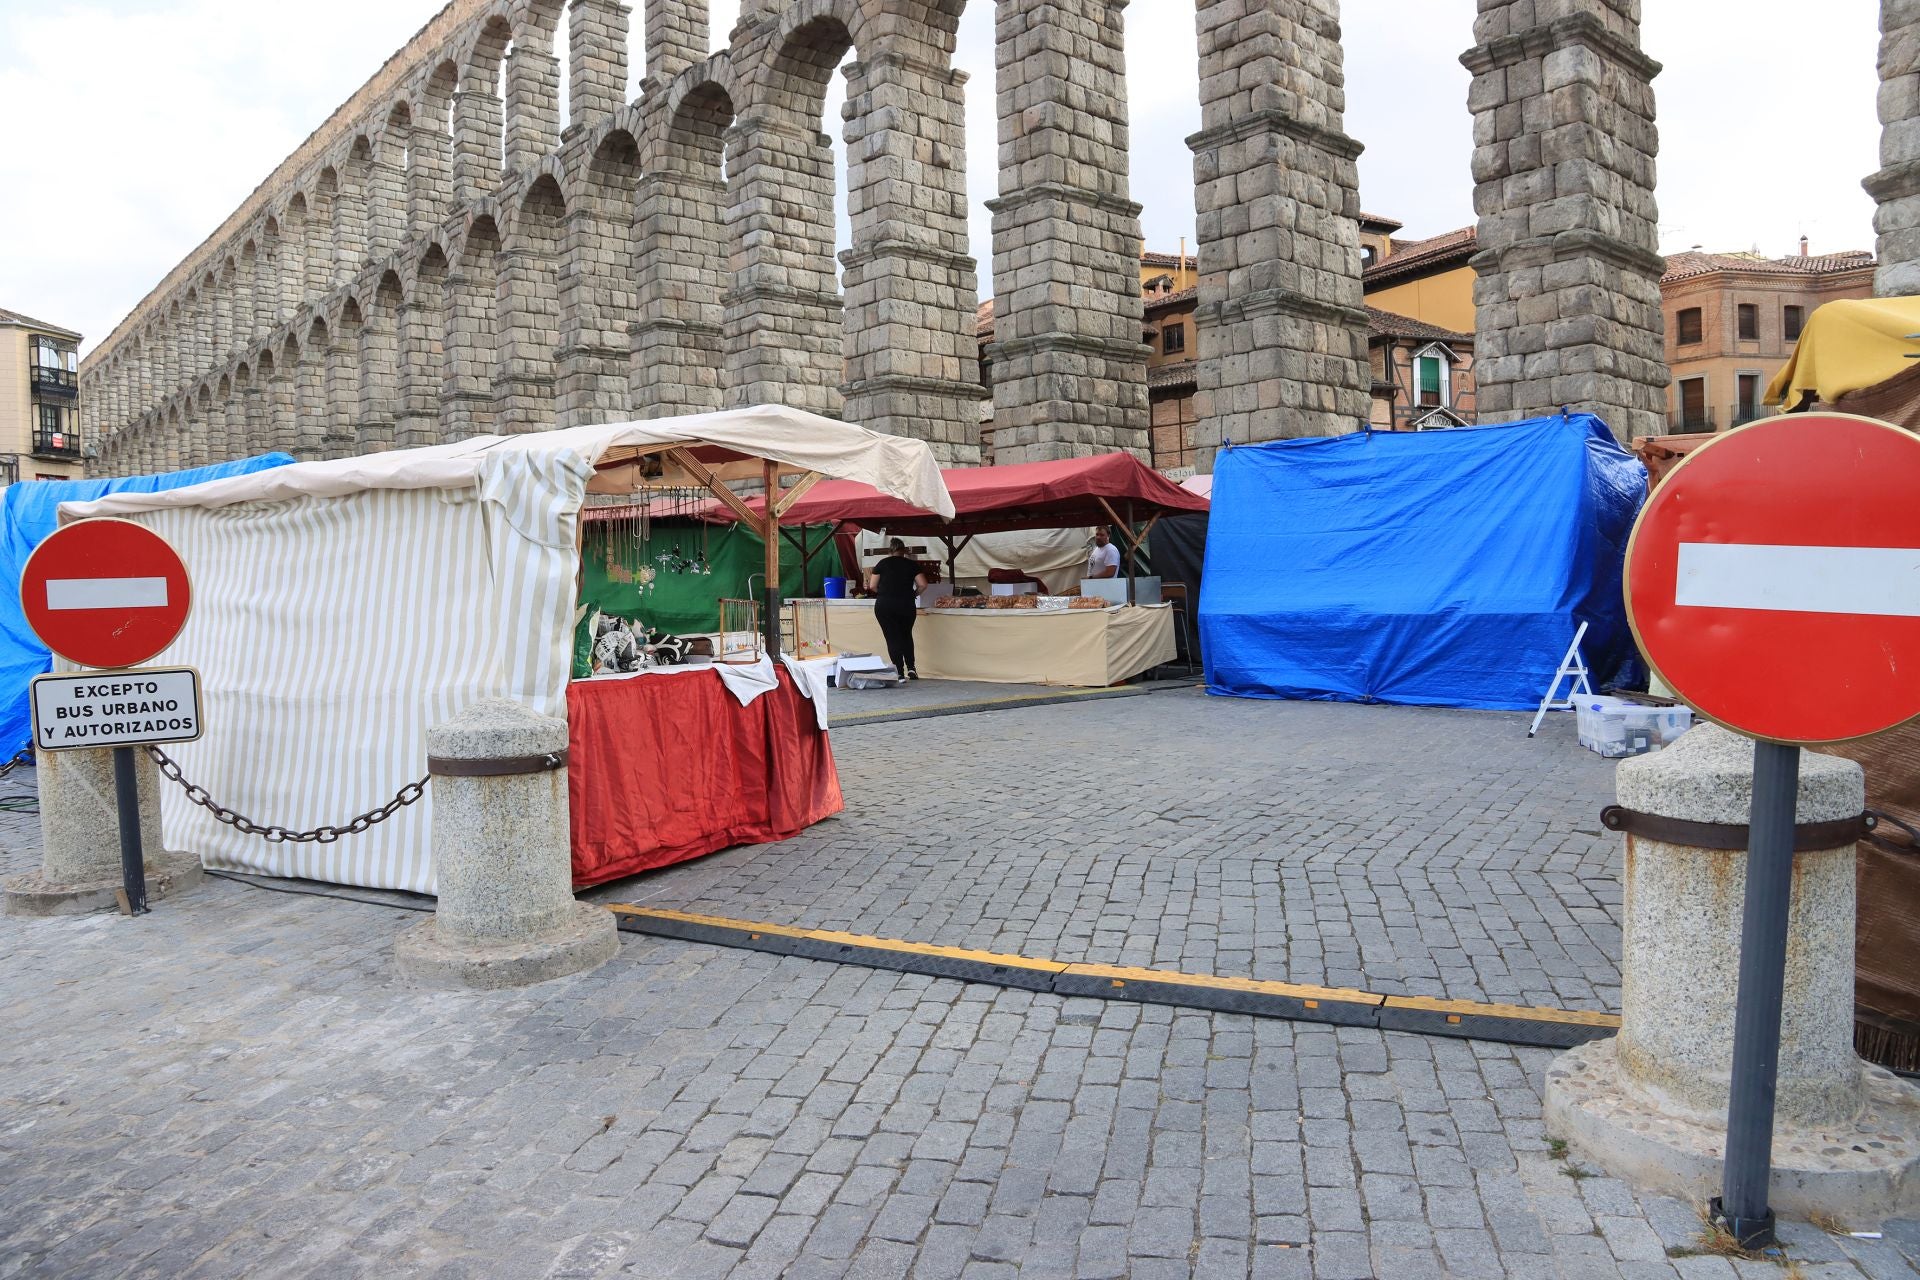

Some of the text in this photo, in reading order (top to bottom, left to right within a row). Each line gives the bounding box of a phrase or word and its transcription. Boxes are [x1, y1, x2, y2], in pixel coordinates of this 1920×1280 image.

[74, 682, 158, 698] EXCEPTO
[56, 699, 178, 719] BUS URBANO
[44, 717, 193, 739] Y AUTORIZADOS
